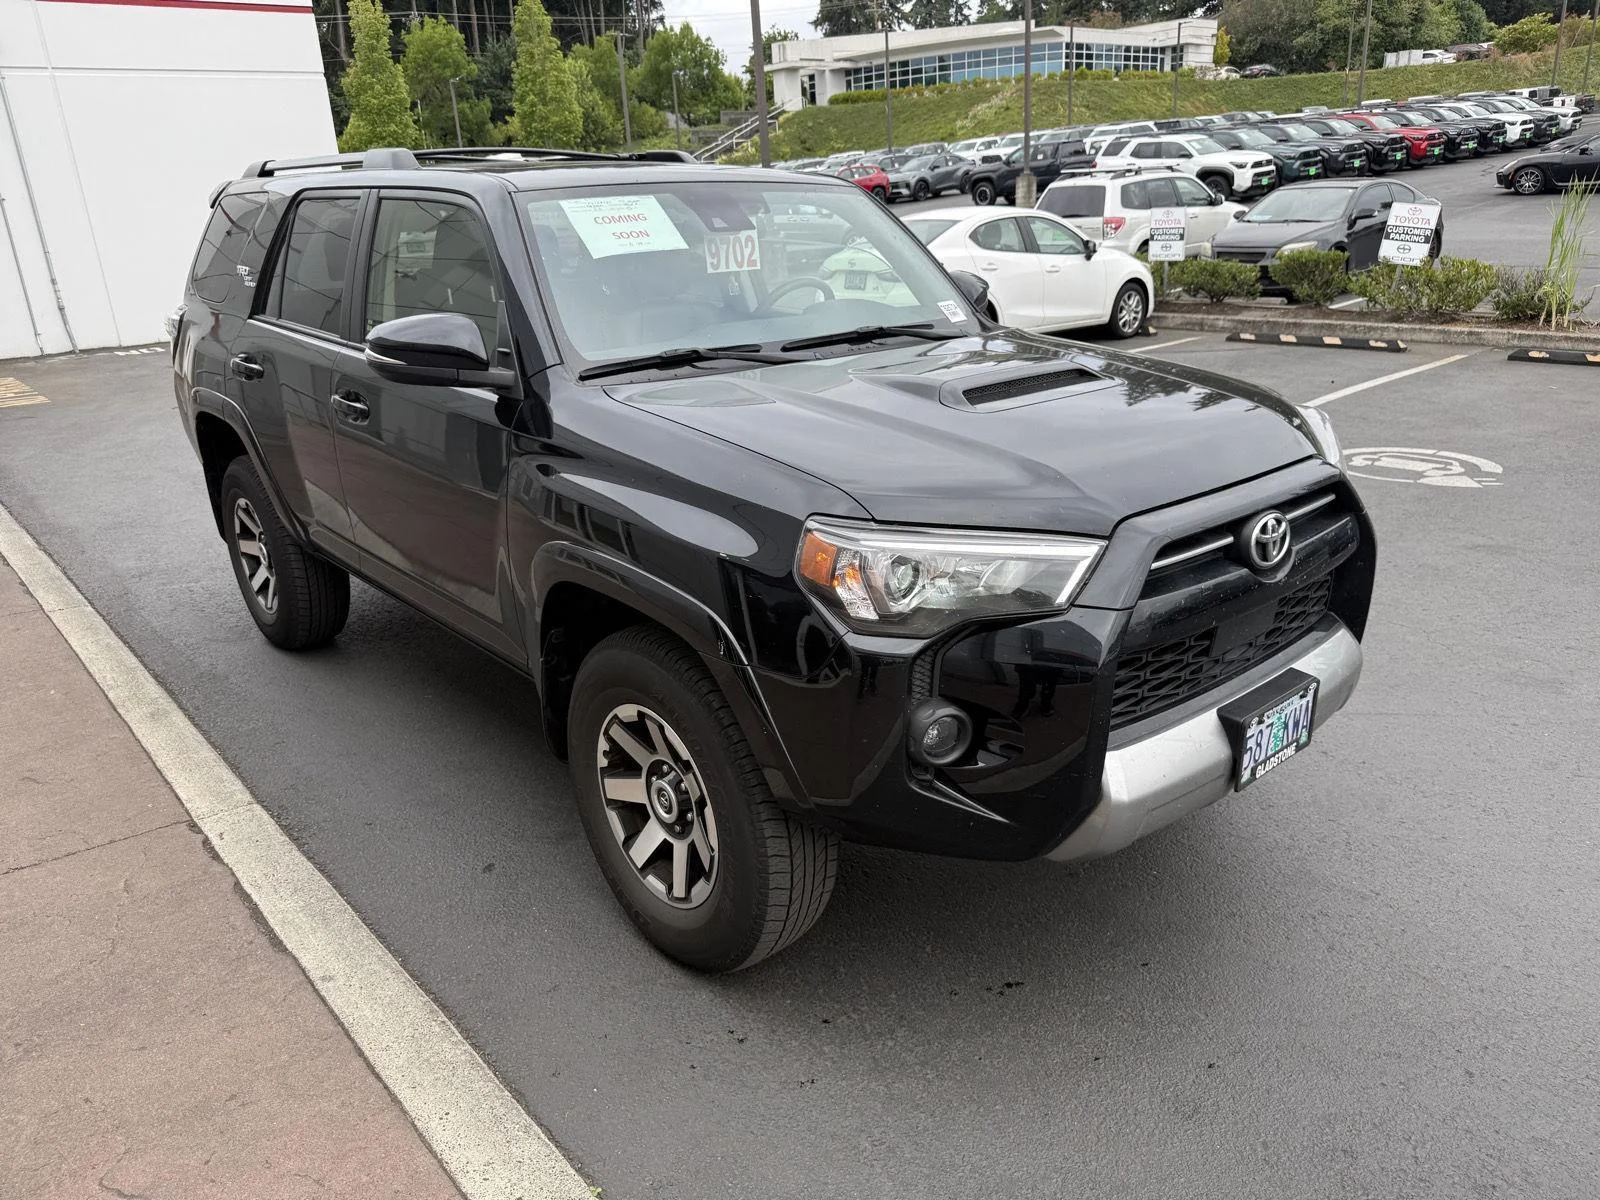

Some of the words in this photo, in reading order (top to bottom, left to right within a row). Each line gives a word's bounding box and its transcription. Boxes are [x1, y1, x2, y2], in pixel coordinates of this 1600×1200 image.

[594, 213, 648, 225] COMING
[1154, 218, 1182, 227] TOYOTA
[1394, 215, 1431, 226] TOYOTA
[611, 230, 650, 240] SOON
[1387, 226, 1432, 237] CUSTOMER
[1390, 233, 1425, 243] PARKING
[708, 234, 758, 271] 9702
[1256, 742, 1297, 778] GLADSTONE
